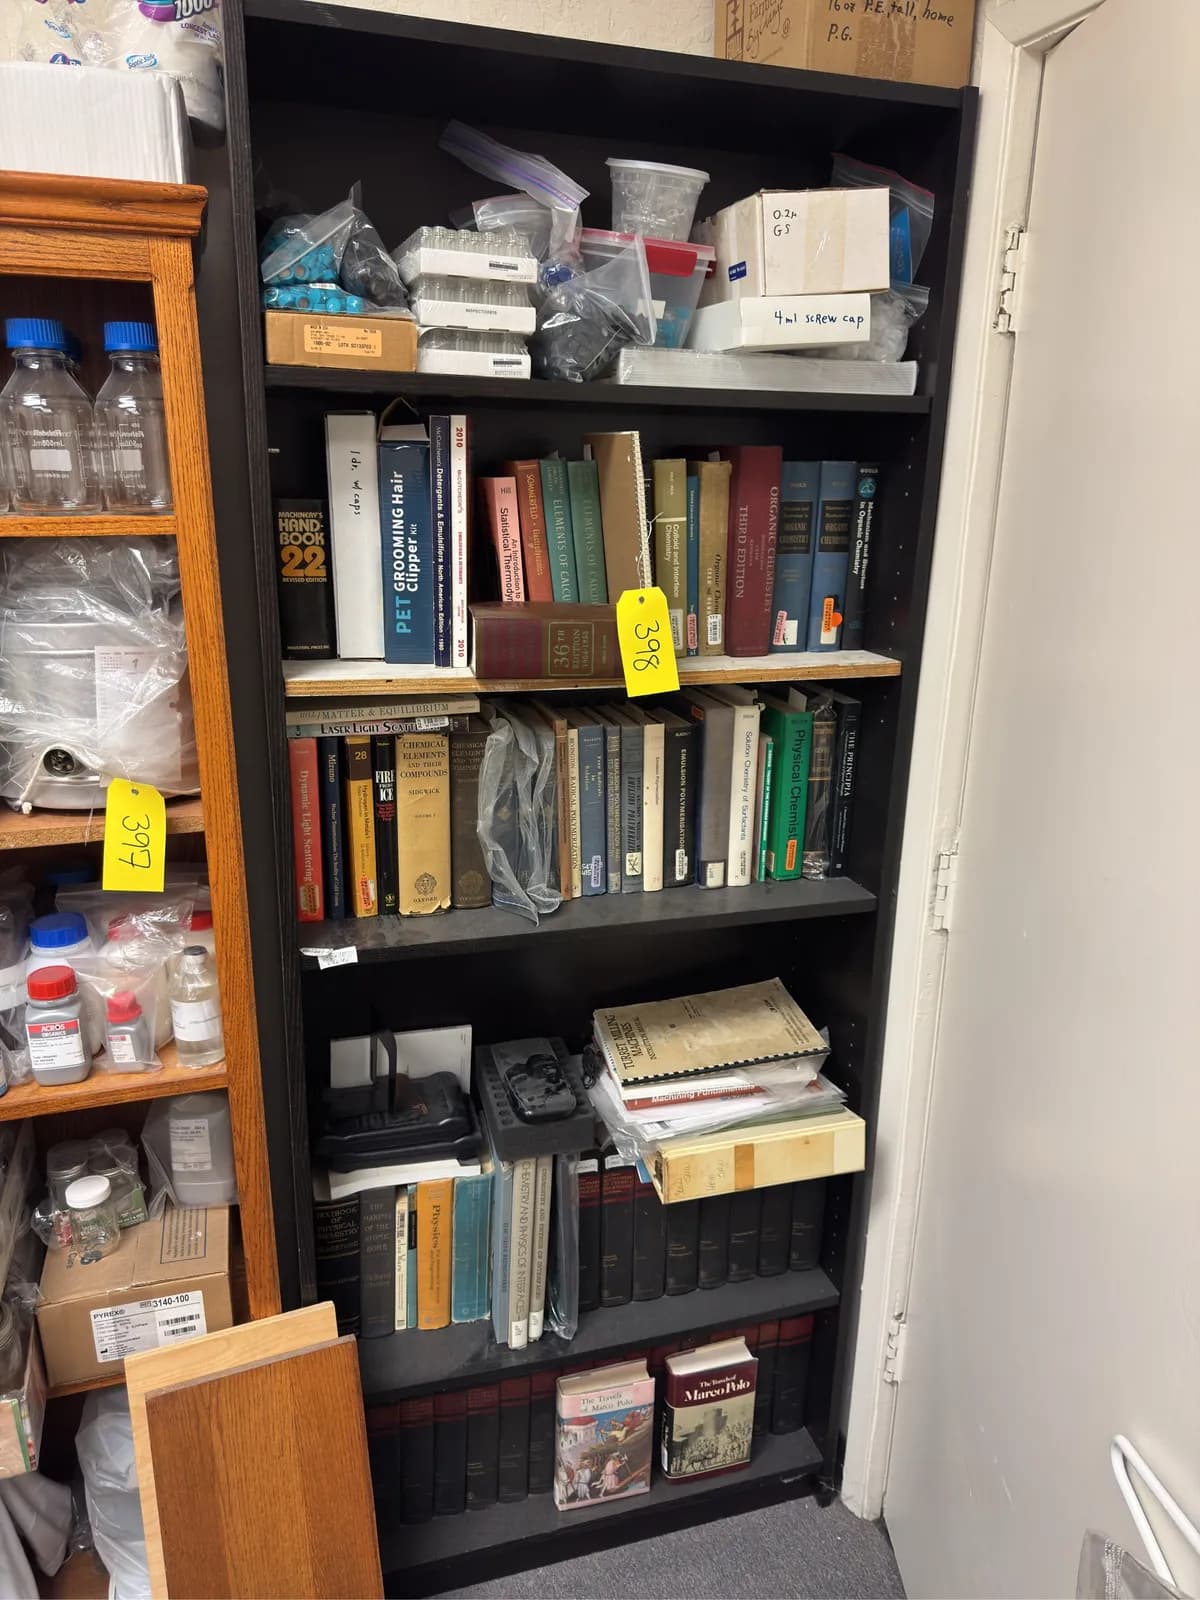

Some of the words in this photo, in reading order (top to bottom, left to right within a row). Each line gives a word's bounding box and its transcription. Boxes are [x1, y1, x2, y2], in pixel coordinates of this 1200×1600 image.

[922, 3, 954, 27] home
[828, 24, 853, 42] P.G.
[842, 315, 864, 329] cap
[390, 471, 404, 504] Hair
[526, 474, 538, 520] SOMMERFELD
[352, 493, 361, 516] caps
[768, 486, 779, 543] ORGANIC
[278, 519, 324, 532] HAND-
[500, 507, 509, 550] Statistical
[553, 499, 567, 549] ELEMENTS
[672, 524, 680, 551] Colloid
[737, 505, 748, 544] THIRD
[856, 510, 866, 539] Organic
[865, 501, 874, 543] Mechanism
[280, 532, 325, 545] BOOK
[392, 509, 405, 591] GROOMING
[511, 538, 518, 550] An
[664, 524, 673, 562] Chemistry
[281, 545, 326, 577] 22
[406, 537, 421, 592] Clipper
[511, 551, 520, 588] Introduction
[559, 552, 569, 567] OF
[713, 553, 721, 586] Organic
[852, 539, 863, 575] Chemistry
[503, 552, 514, 602] Thermodyn
[560, 570, 572, 603] CALCU
[735, 548, 746, 599] EDITION
[763, 547, 776, 614] CHEMISTRY
[514, 589, 520, 599] to
[396, 598, 412, 633] PET
[632, 620, 660, 671] 398
[322, 706, 365, 720] MATTER
[368, 708, 375, 717] &
[379, 703, 450, 716] EQUILIBRIUM
[320, 722, 351, 735] LASER
[352, 722, 380, 734] LIGHT
[402, 740, 447, 749] CHEMICAL
[744, 730, 753, 758] Solution
[848, 730, 856, 750] THE
[328, 754, 336, 783] Mizuno
[354, 751, 367, 760] 28
[402, 751, 447, 760] ELEMENTS
[790, 729, 806, 783] Physical
[299, 770, 309, 809] Dynamic
[400, 770, 448, 778] COMPOUNDS
[741, 759, 752, 793] Chemistry
[843, 752, 855, 797] PRINCIPIA
[380, 788, 394, 801] ICE
[408, 788, 441, 796] SIDGWICK
[301, 813, 310, 838] Light
[678, 788, 686, 849] POLYMERISATION
[740, 804, 749, 841] Surfactants
[787, 786, 802, 840] Chemist
[117, 813, 151, 869] 397
[571, 809, 579, 870] POLYMERIZATION
[302, 838, 312, 882] Scattering
[41, 1023, 65, 1032] ACROS
[620, 1022, 643, 1057] MACHINES
[615, 1043, 635, 1070] TURRET
[519, 1161, 531, 1204] CHEMISTRY
[432, 1204, 441, 1249] Physics
[519, 1205, 529, 1224] AND
[517, 1225, 528, 1257] PHYSICS
[517, 1258, 526, 1268] OF
[152, 1294, 190, 1308] 3140-100
[515, 1271, 526, 1313] INTERFACES
[581, 1397, 594, 1405] The
[599, 1392, 622, 1403] Travels
[684, 1386, 725, 1402] Marco
[725, 1379, 750, 1395] Polo
[699, 1379, 711, 1388] The
[591, 1404, 614, 1412] Marco
[617, 1399, 633, 1408] Polo
